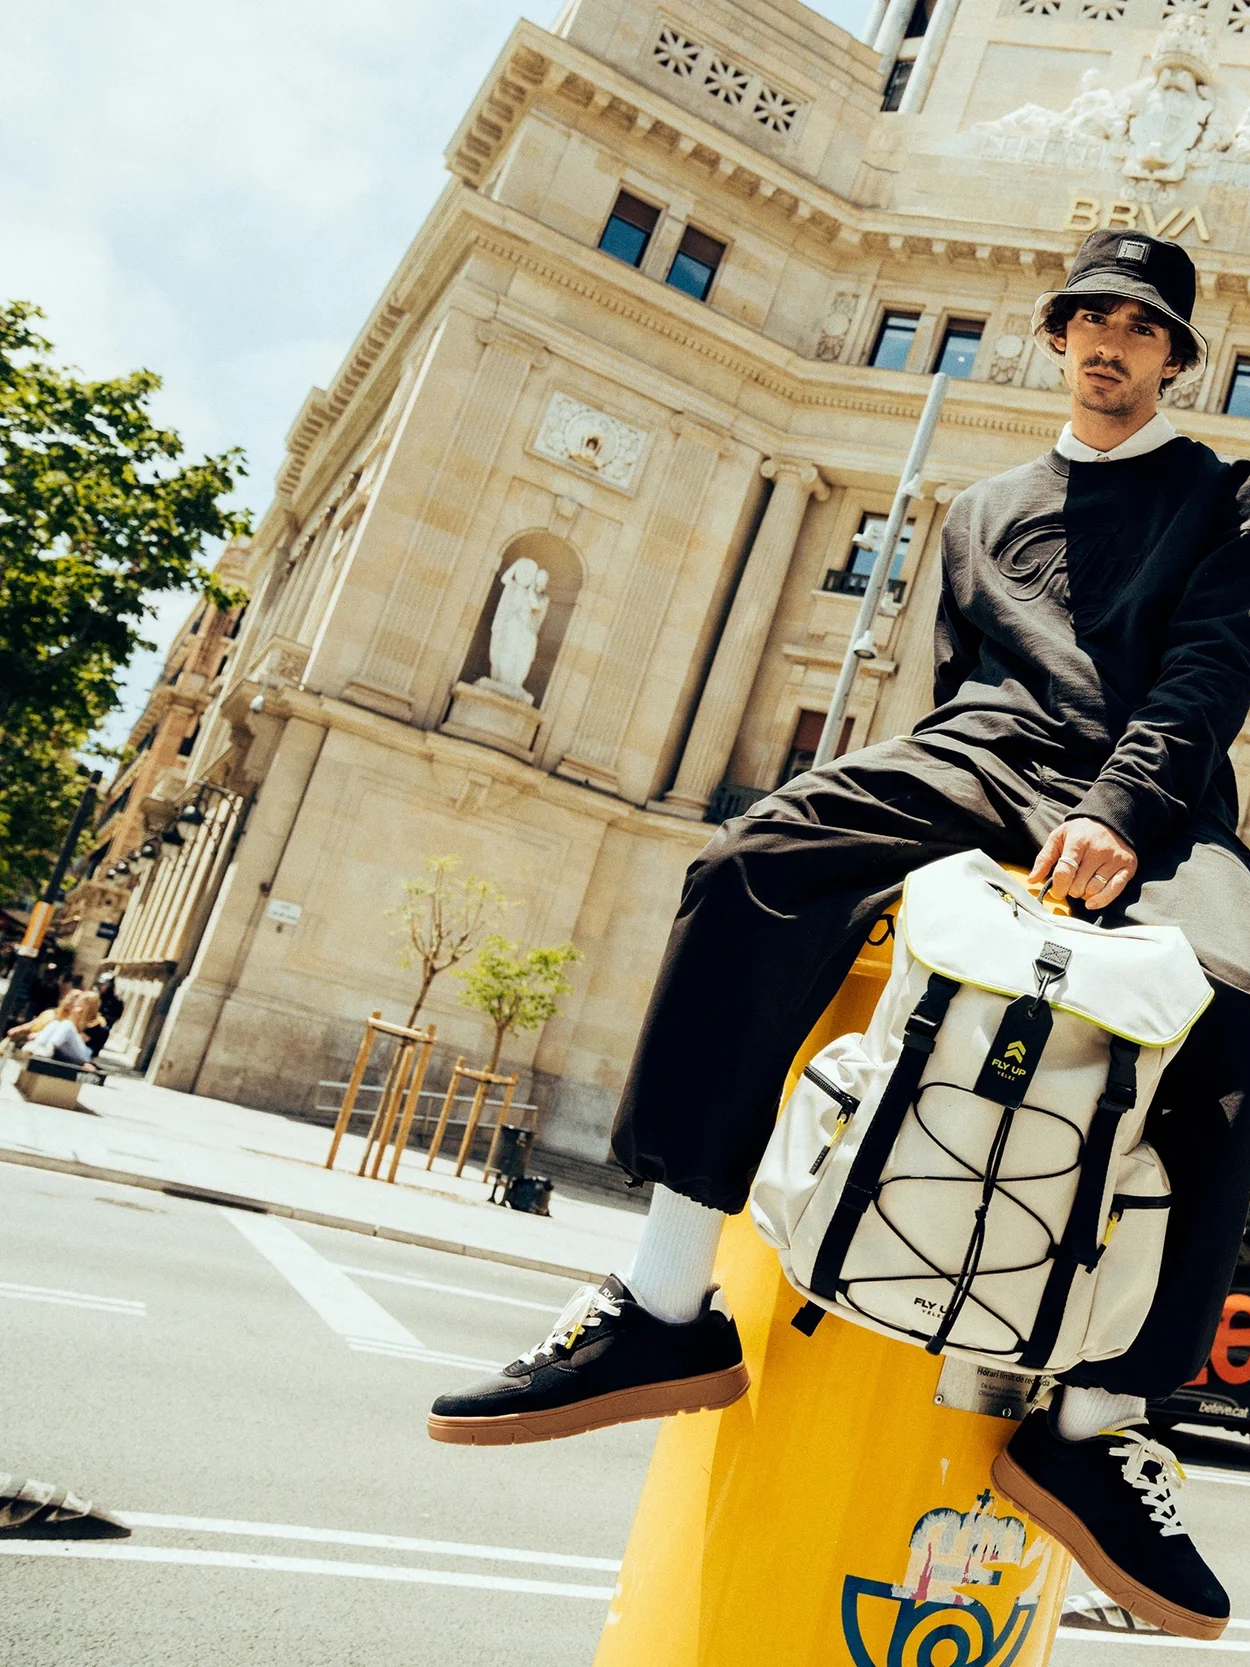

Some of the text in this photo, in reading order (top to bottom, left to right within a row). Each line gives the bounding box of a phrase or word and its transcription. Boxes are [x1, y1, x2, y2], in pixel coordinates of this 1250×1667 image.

[1064, 198, 1210, 242] BBVA
[992, 1058, 1026, 1076] FLY UP
[914, 1297, 947, 1314] FLY U
[977, 1367, 999, 1378] Horari
[1015, 1374, 1024, 1383] de
